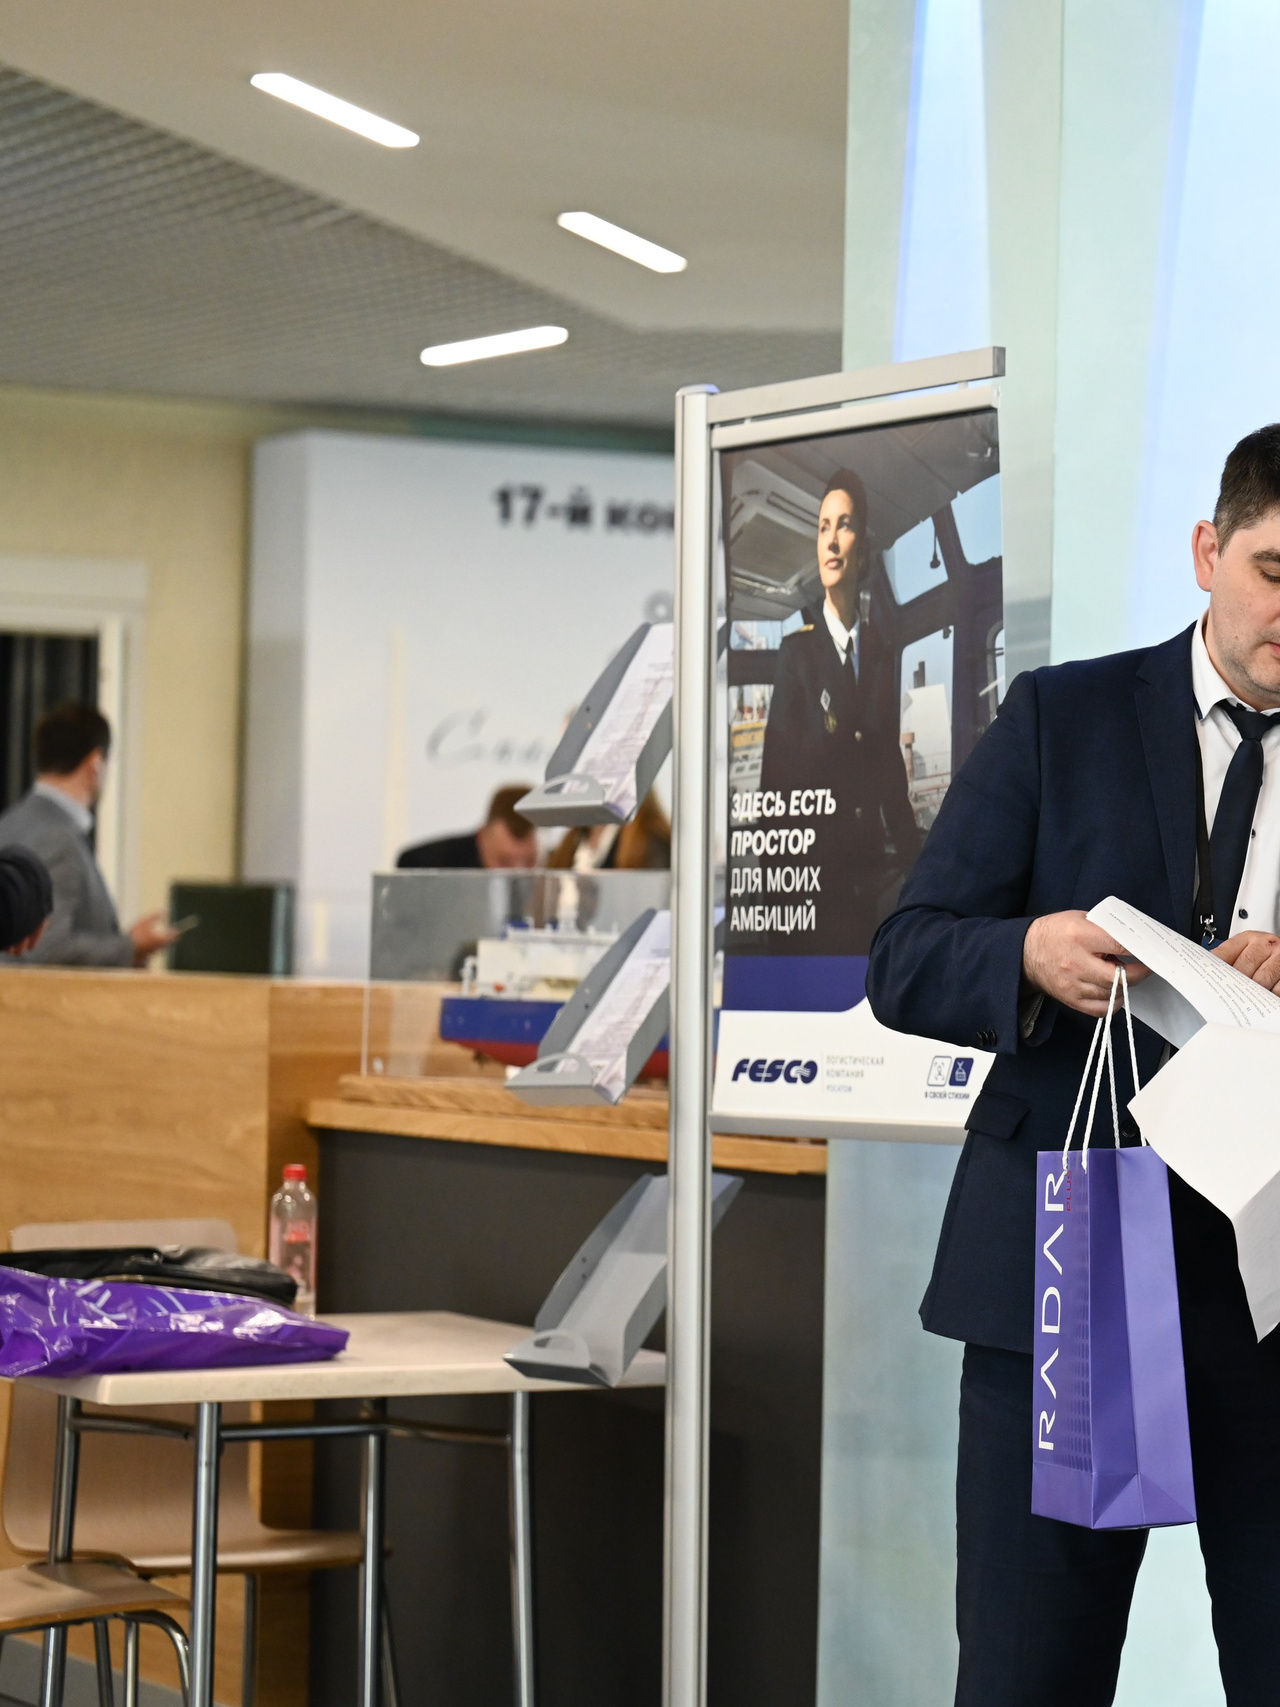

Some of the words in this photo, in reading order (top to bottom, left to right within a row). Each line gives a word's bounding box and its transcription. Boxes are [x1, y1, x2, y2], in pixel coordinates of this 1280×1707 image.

[731, 791, 786, 822] ЗДЕСЬ
[789, 788, 837, 816] ЕСТЬ
[731, 828, 816, 856] ПРОСТОР
[730, 867, 762, 898] ДЛЯ
[766, 866, 821, 893] МОИХ
[730, 899, 816, 935] АМБИЦИЙ
[731, 1058, 818, 1085] FESCO
[826, 1069, 864, 1079] КОМПАНИЯ
[1038, 1170, 1067, 1450] RADAR
